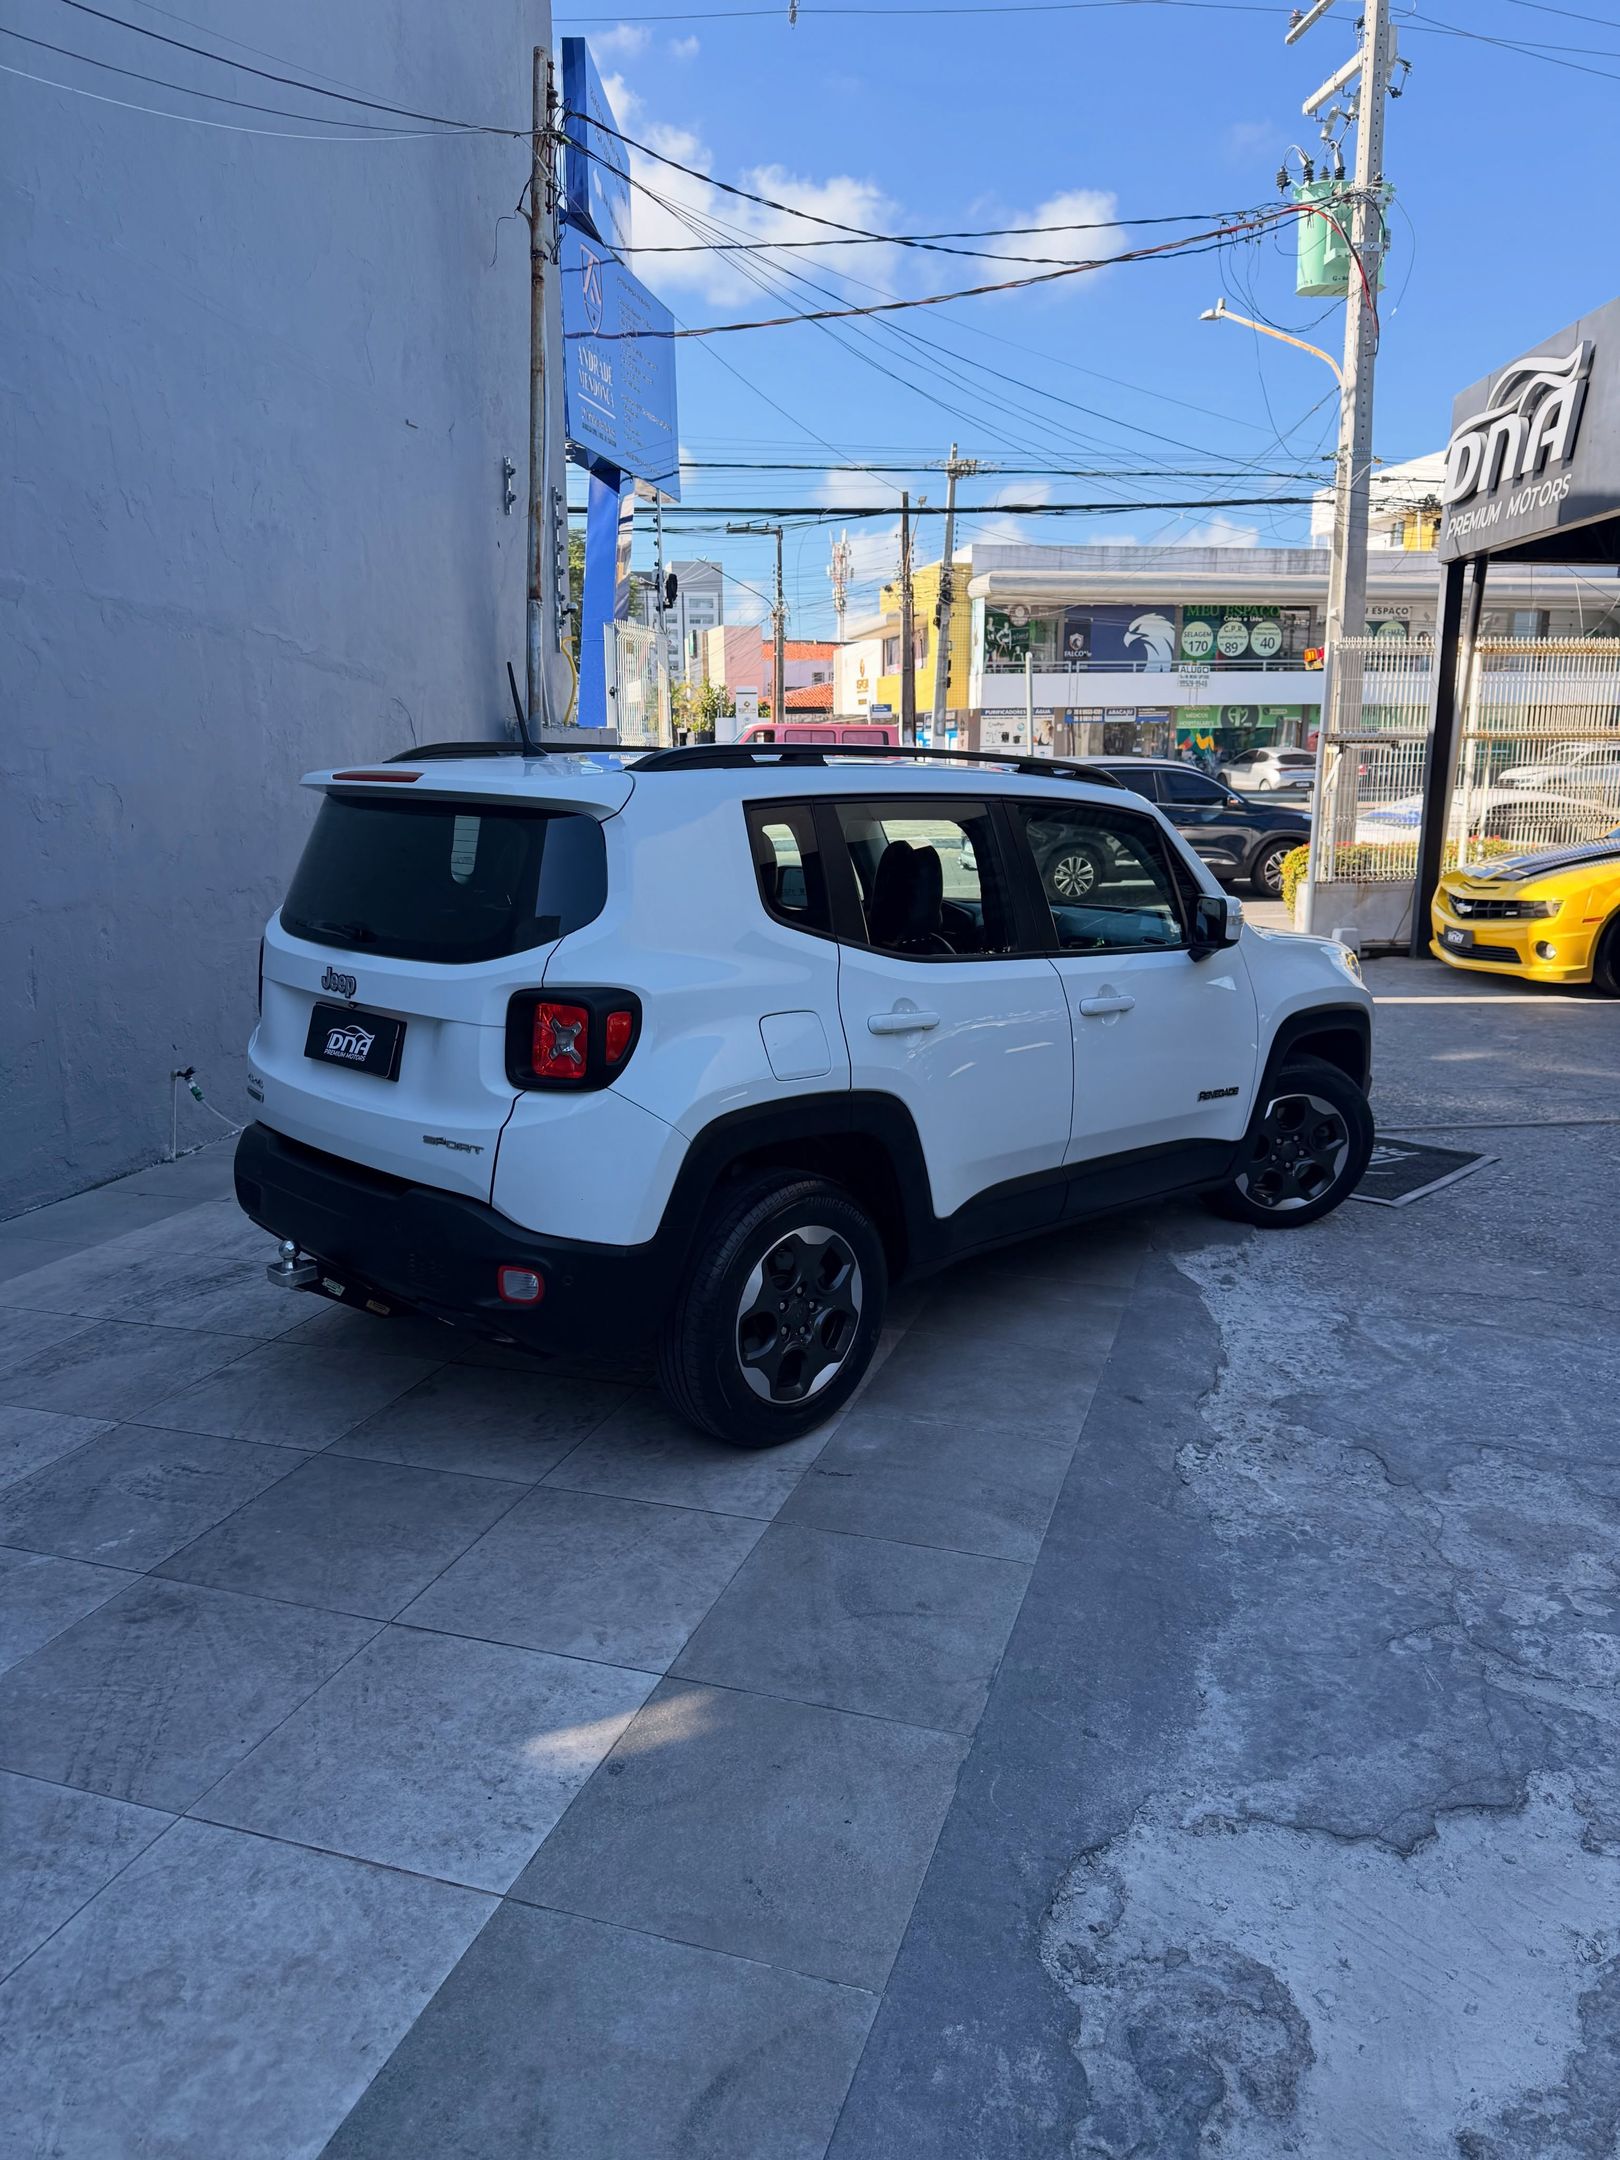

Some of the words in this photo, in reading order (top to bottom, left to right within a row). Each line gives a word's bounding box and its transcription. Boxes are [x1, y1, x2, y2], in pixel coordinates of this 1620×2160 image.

[578, 345, 613, 387] ANDRADE
[1446, 502, 1502, 540] PREMIUM
[1506, 473, 1572, 518] MOTORS
[1186, 605, 1220, 617] MEU
[1371, 607, 1409, 617] ESPAÇO
[1188, 641, 1209, 652] 170
[1224, 642, 1239, 653] 89
[1260, 637, 1275, 650] 40
[1180, 666, 1210, 674] ALUGO
[984, 708, 1028, 716] PURIFICADORES
[320, 965, 357, 998] Jeep
[326, 1033, 373, 1056] DNA
[323, 1048, 346, 1058] PREMIUM
[346, 1052, 367, 1062] MOTORS
[1197, 1086, 1240, 1102] RENEGADE
[422, 1134, 485, 1155] SPORT
